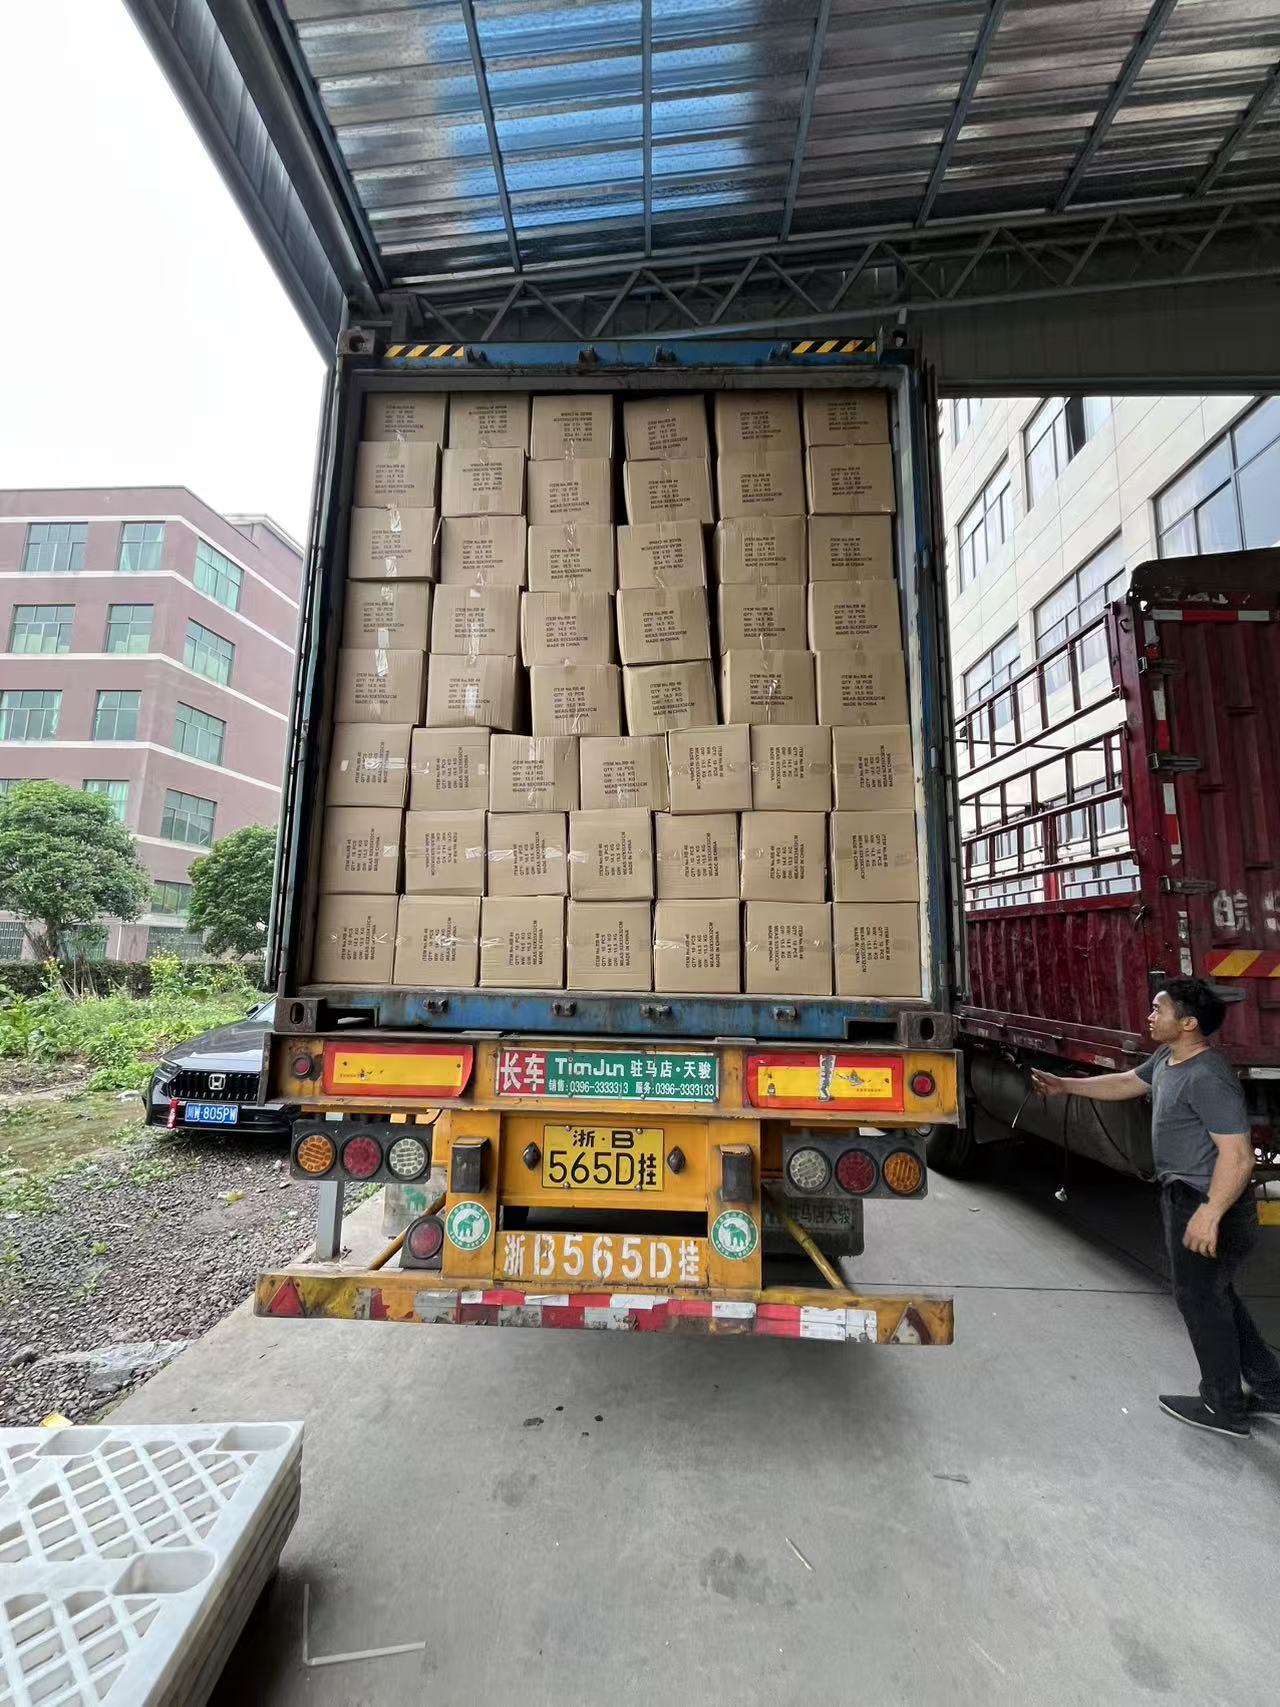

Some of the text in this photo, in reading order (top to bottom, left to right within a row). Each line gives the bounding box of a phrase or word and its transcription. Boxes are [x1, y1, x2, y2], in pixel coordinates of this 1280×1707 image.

[501, 1052, 545, 1091] 长车
[555, 1057, 624, 1077] TianJun
[548, 1151, 657, 1186] 565D挂
